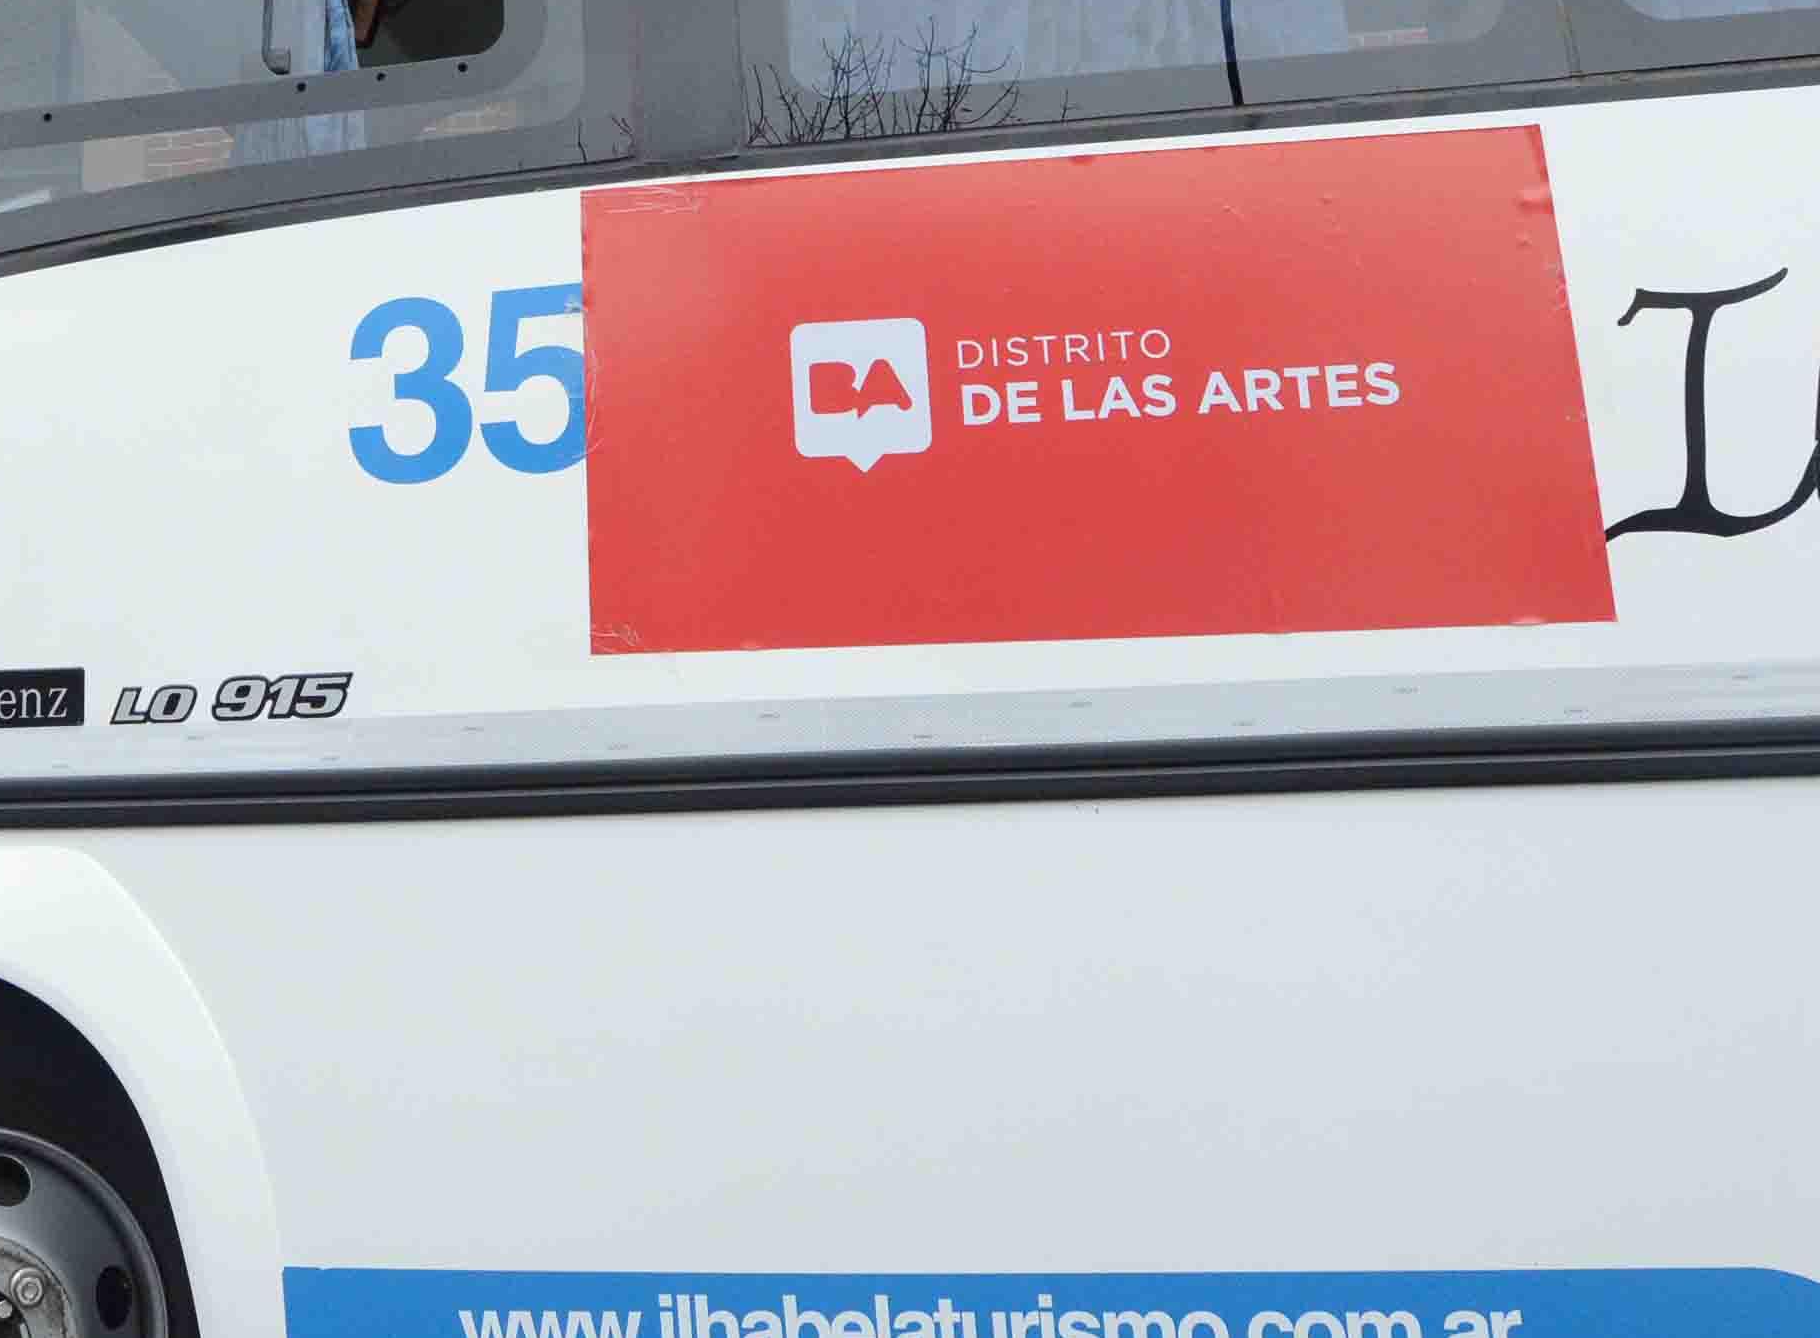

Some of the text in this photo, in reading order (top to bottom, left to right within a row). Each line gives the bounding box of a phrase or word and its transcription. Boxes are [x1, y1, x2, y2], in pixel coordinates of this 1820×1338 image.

[956, 329, 1172, 370] DISTRITO
[349, 281, 585, 485] 35
[961, 361, 1401, 426] DE LAS ARTES
[109, 672, 354, 725] LO 915
